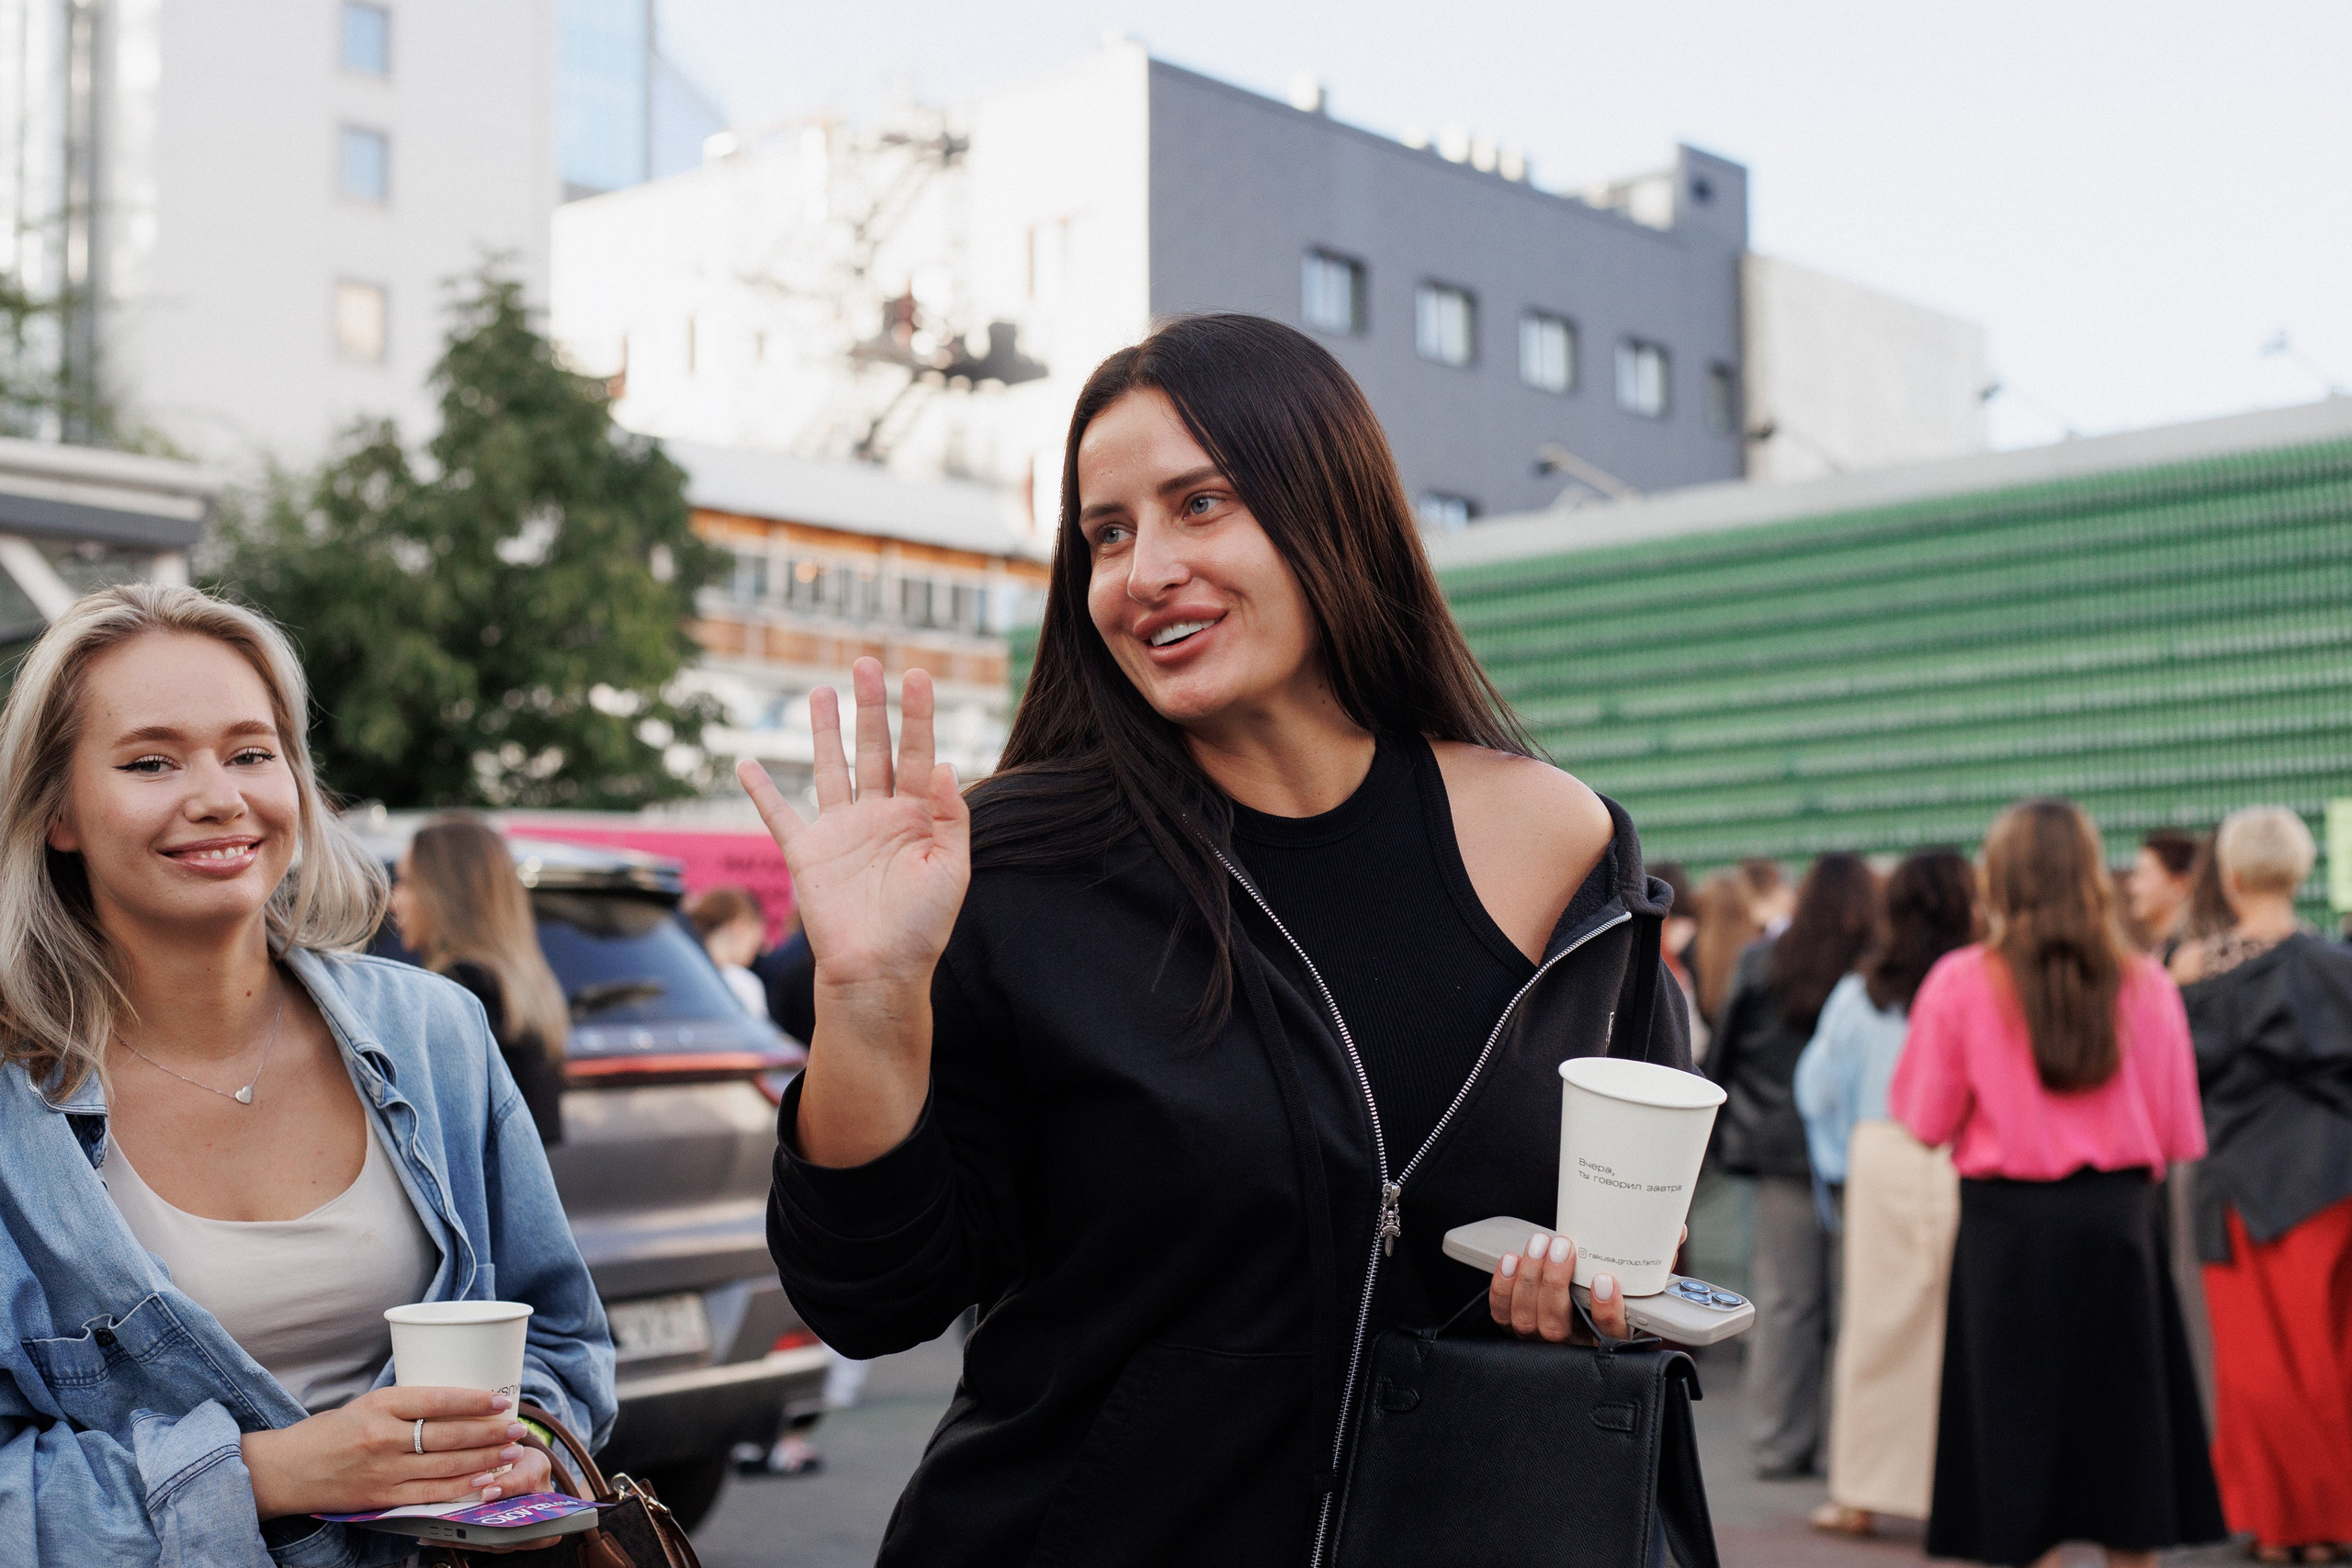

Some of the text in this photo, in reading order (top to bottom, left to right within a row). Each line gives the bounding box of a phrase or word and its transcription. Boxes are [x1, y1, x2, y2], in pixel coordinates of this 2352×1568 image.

[1578, 1157, 1615, 1176] Вчера,
[1578, 1170, 1682, 1192] ты говорил завтра
